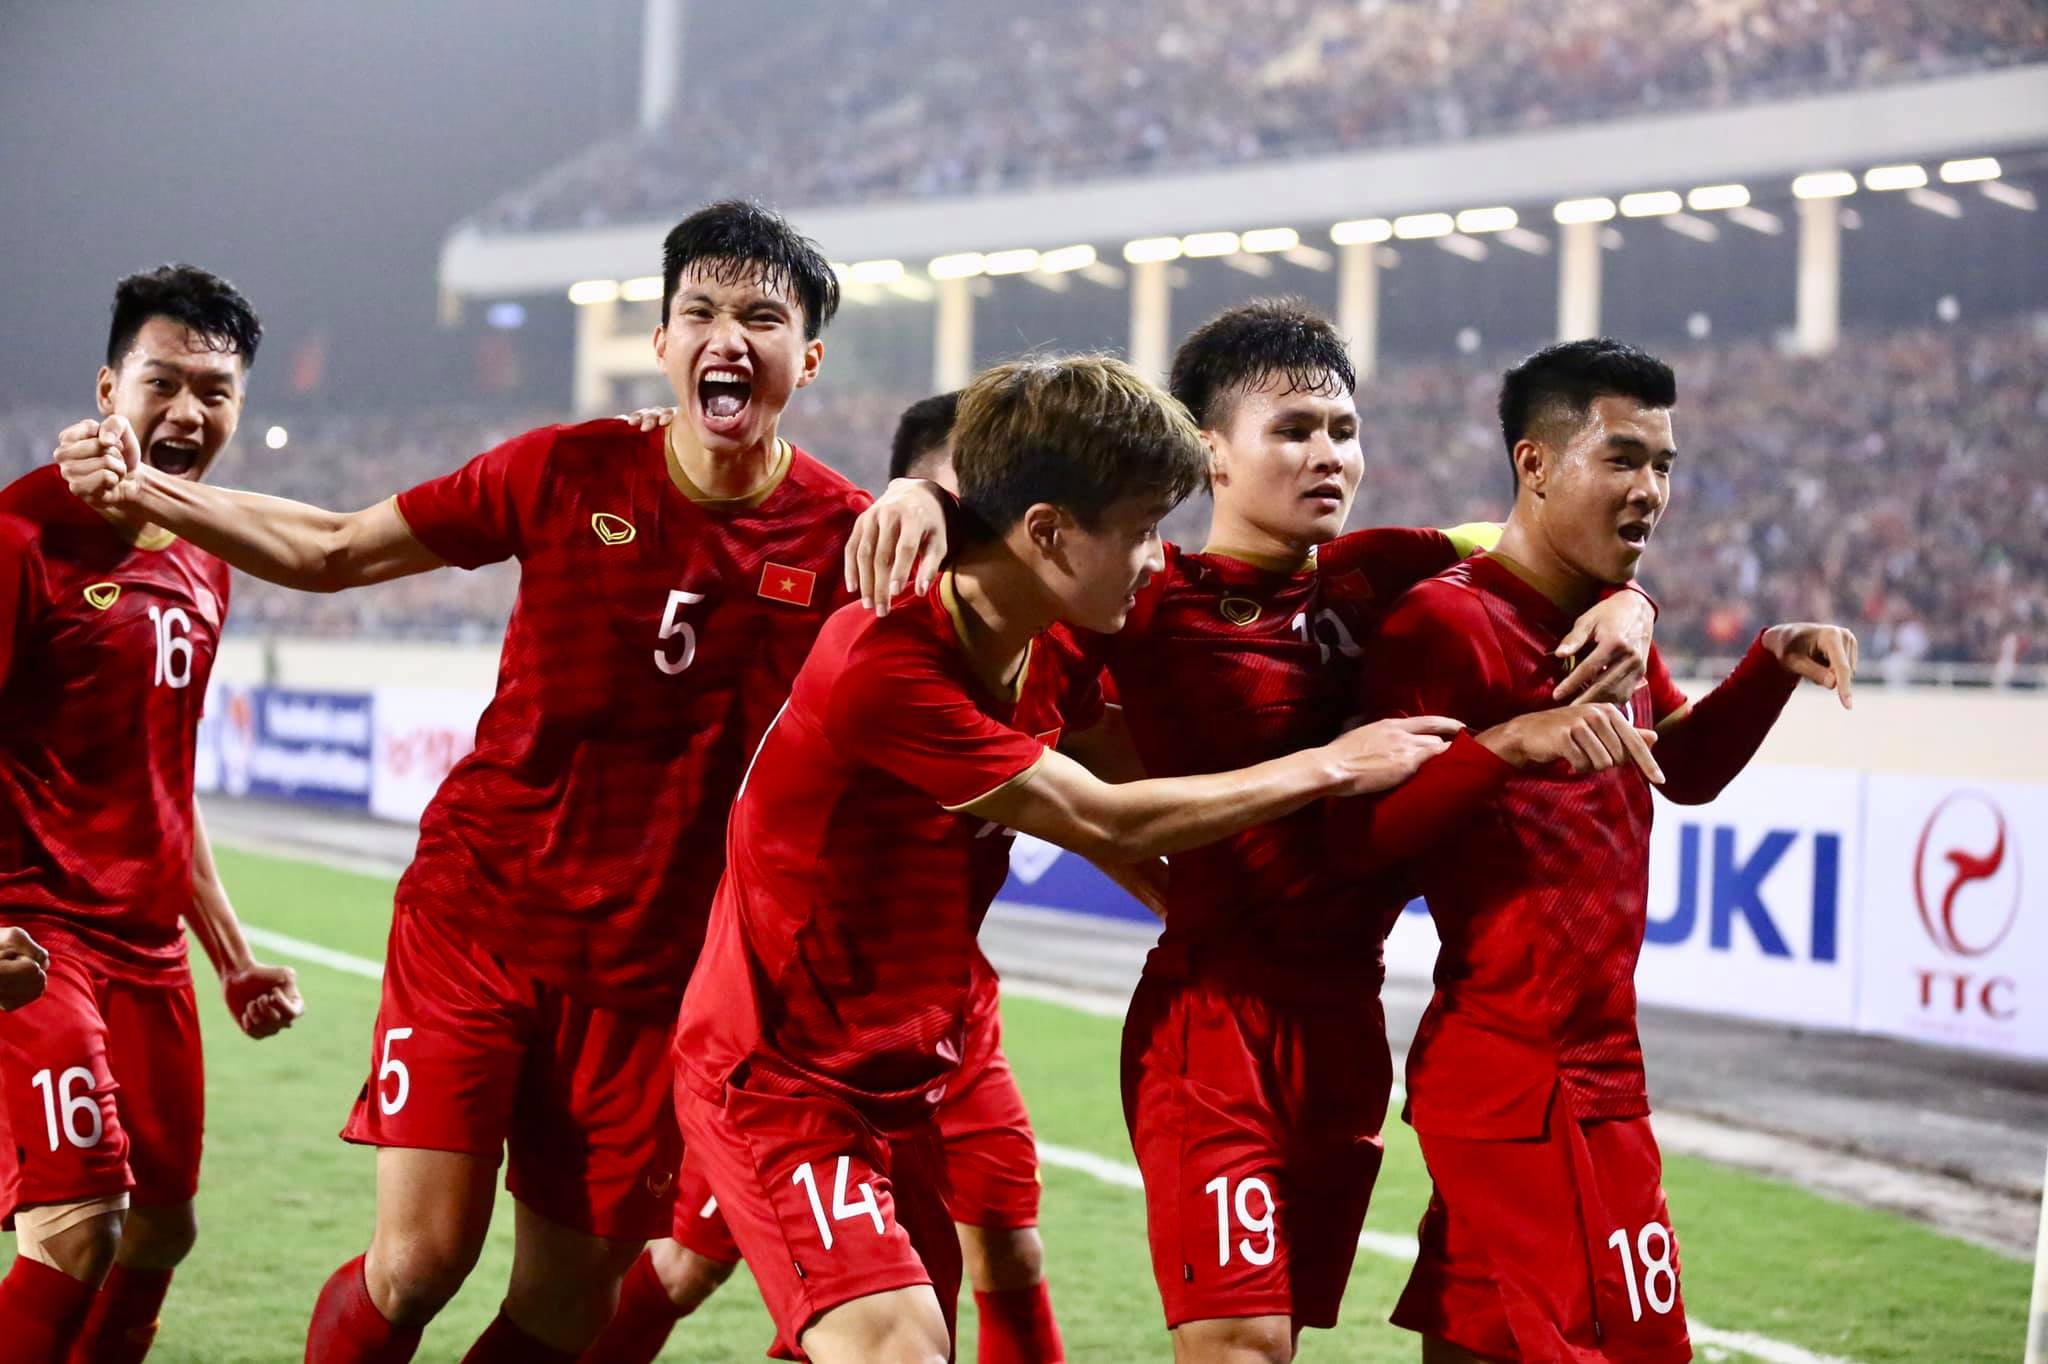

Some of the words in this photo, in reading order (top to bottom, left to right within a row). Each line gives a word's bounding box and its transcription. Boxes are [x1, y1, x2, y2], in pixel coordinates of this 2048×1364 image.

[147, 605, 194, 689] 16
[654, 590, 704, 674] 5
[1915, 970, 2018, 1019] TTC
[31, 1066, 101, 1152] 16
[378, 1027, 413, 1115] 5
[792, 1155, 886, 1250] 14
[1205, 1176, 1276, 1267] 19
[1607, 1221, 1677, 1322] 18
